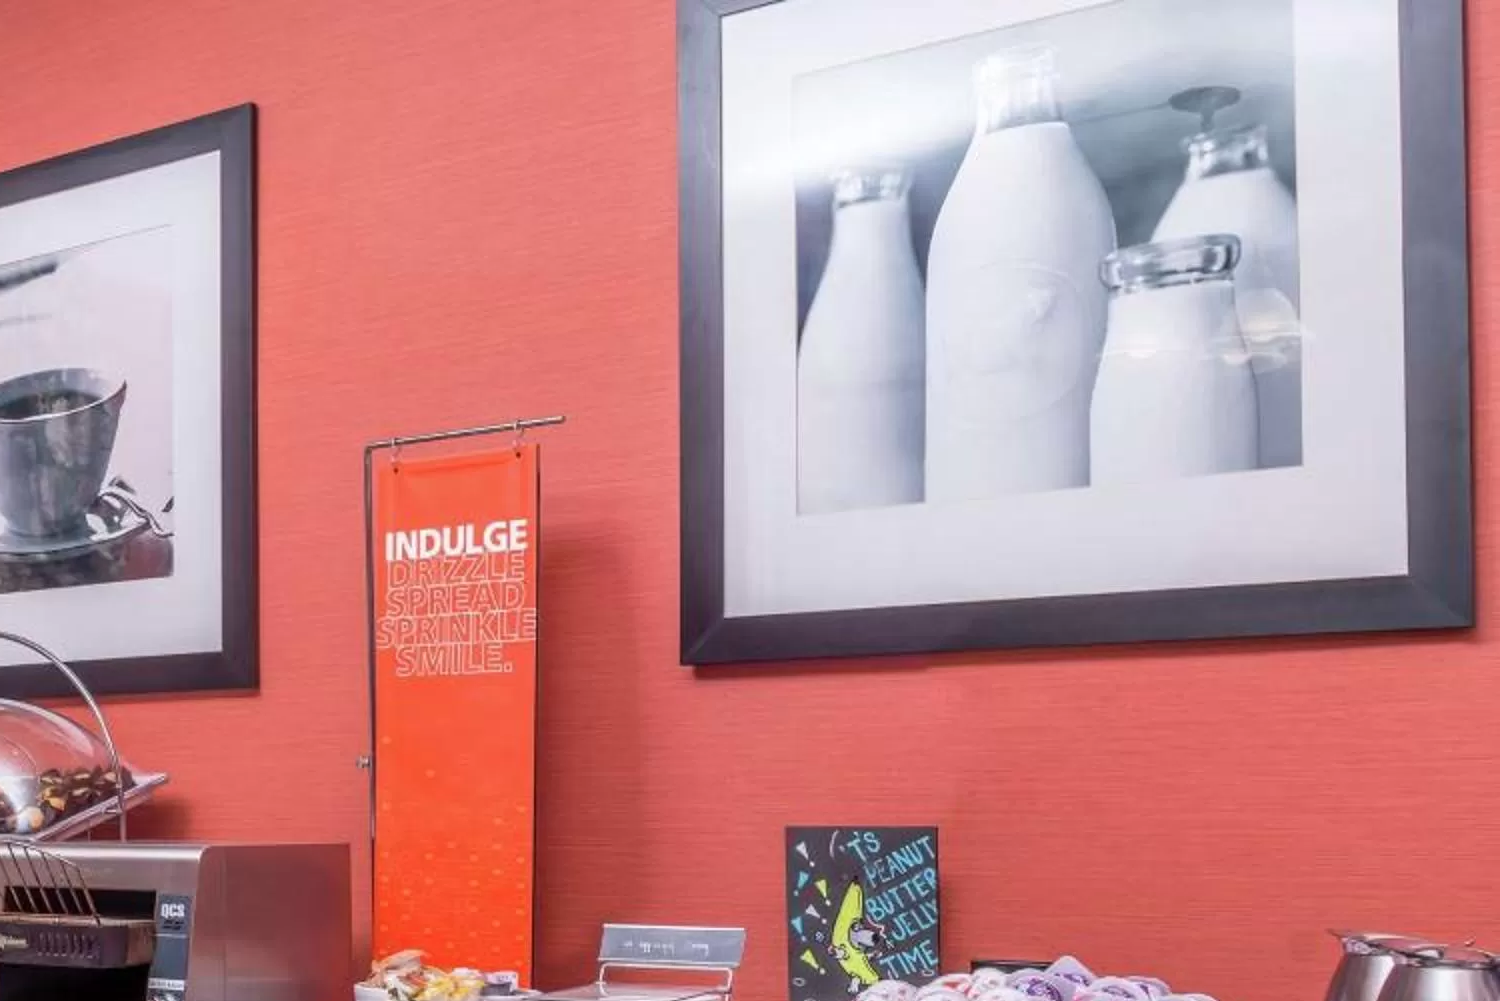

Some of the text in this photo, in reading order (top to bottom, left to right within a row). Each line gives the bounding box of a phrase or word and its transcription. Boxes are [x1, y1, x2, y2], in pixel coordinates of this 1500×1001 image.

[385, 519, 528, 561] INDULGE
[387, 550, 526, 590] DRIZZLE
[386, 580, 525, 617] SPREAD
[376, 607, 537, 648] SPRINKLE
[395, 641, 513, 677] SMILE.
[863, 835, 936, 889] PEANUT
[160, 903, 185, 918] QCS
[864, 868, 937, 921] BUTTER
[879, 939, 939, 980] TIME
